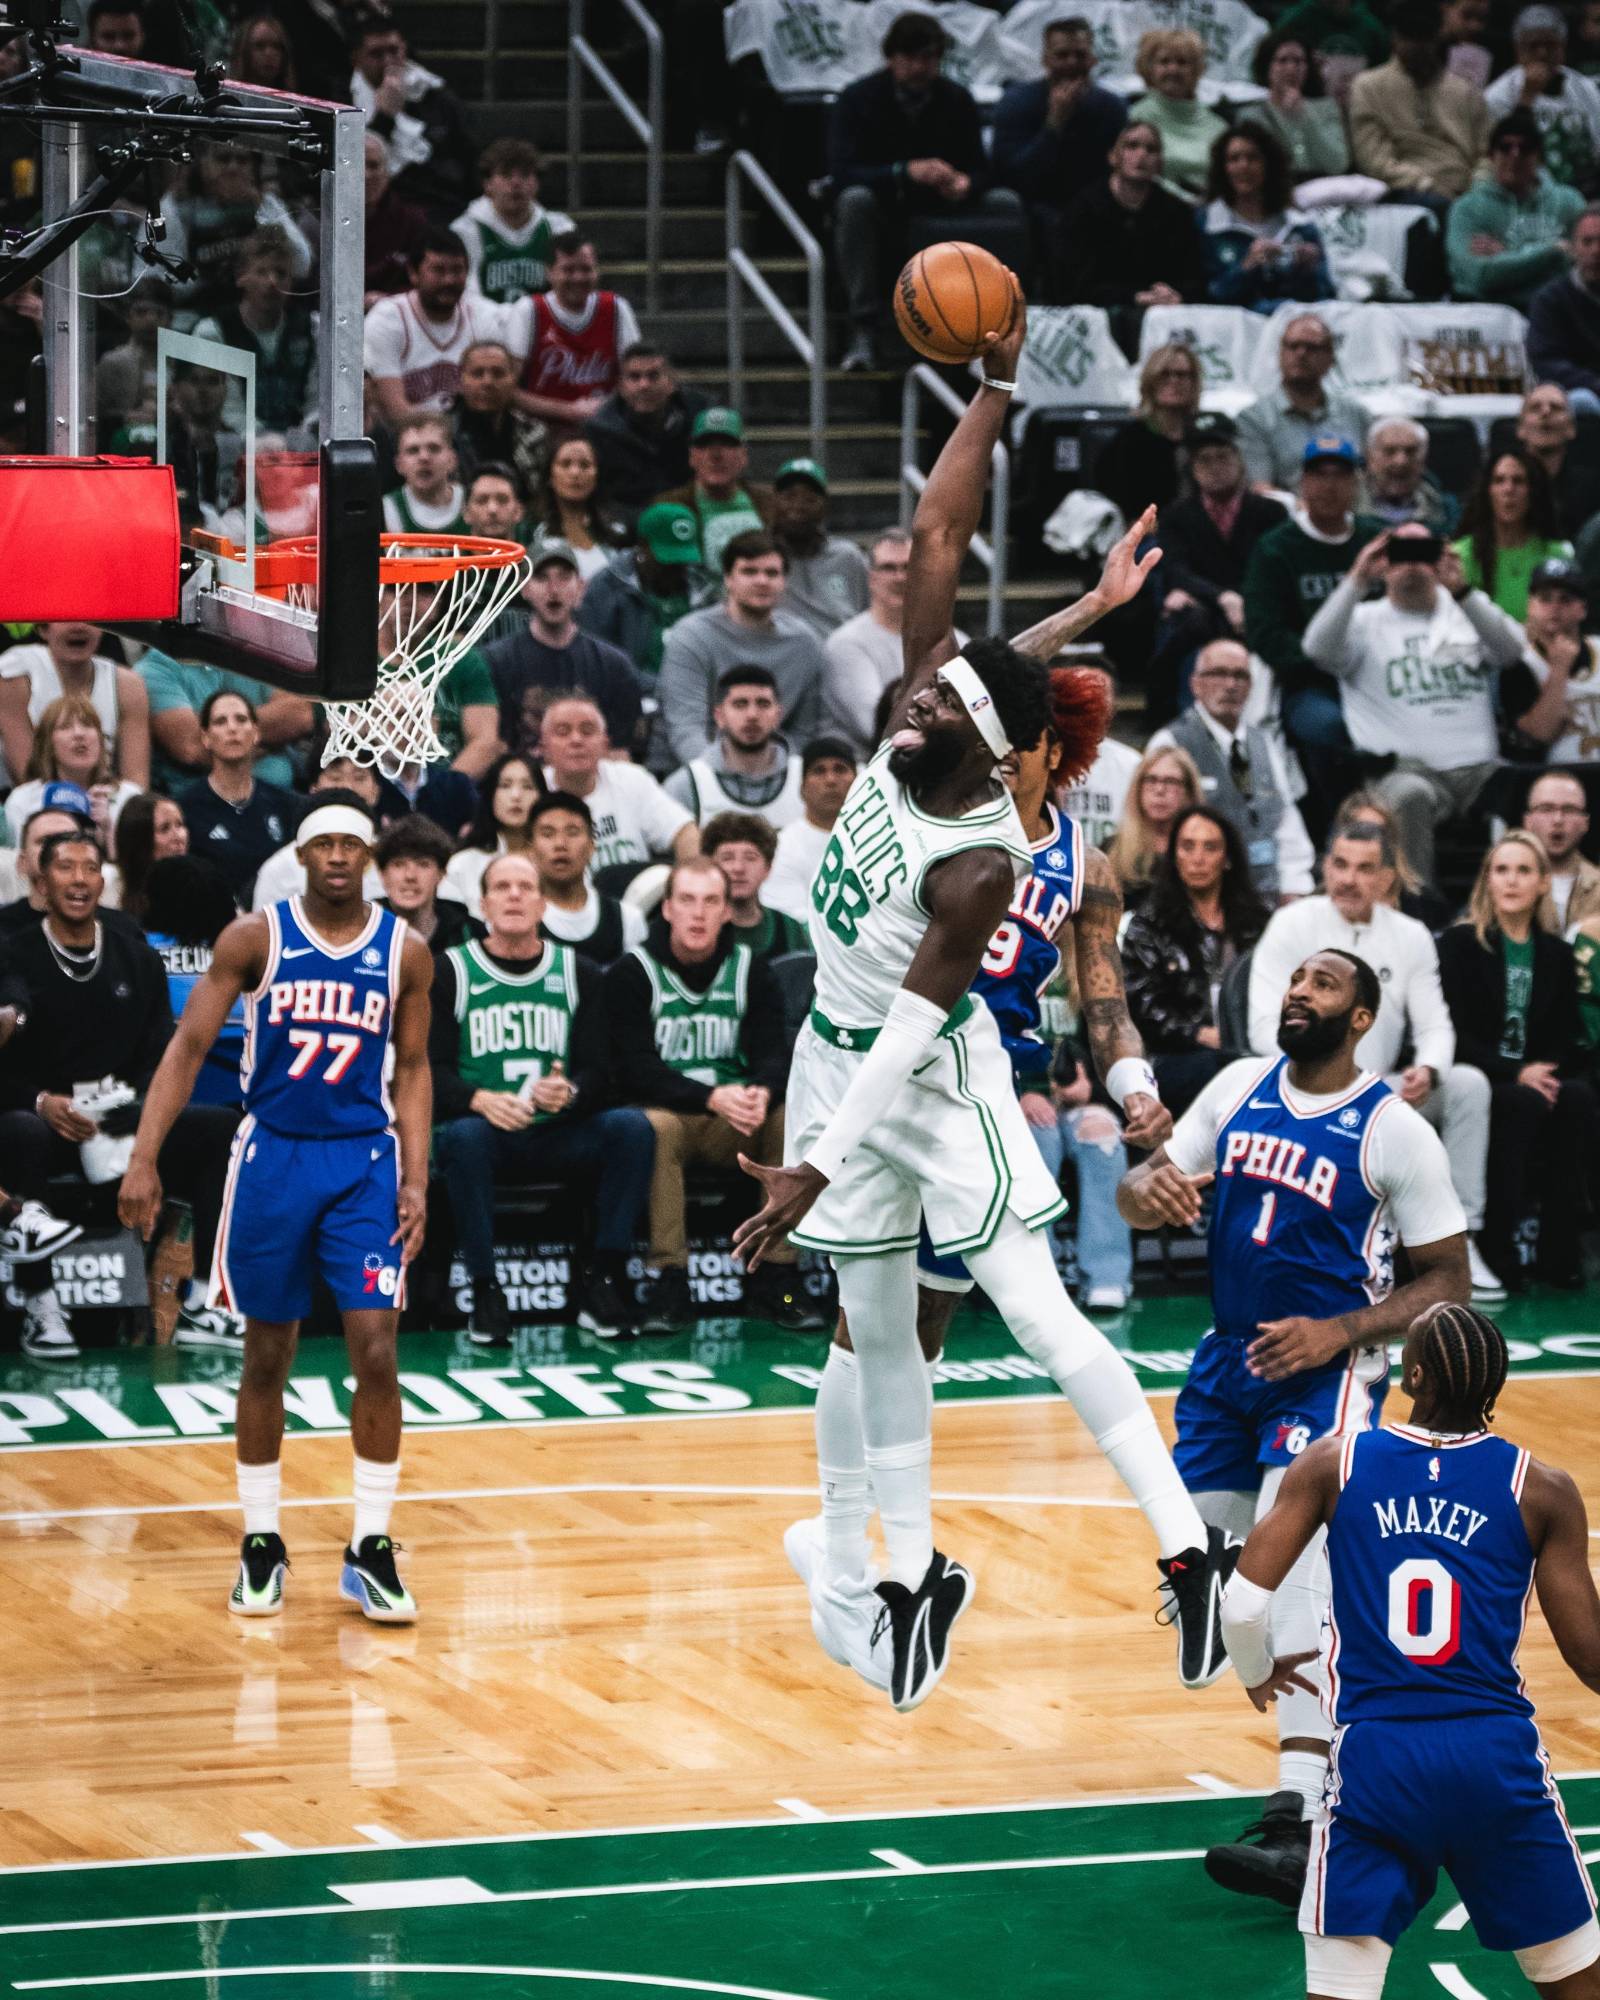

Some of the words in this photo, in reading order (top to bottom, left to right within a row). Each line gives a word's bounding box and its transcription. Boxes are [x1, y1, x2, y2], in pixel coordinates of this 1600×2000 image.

[900, 260, 932, 337] Wilson
[839, 776, 908, 905] CELTICS
[811, 833, 871, 947] 88
[1008, 873, 1071, 942] ILA
[268, 979, 387, 1035] PHILA
[468, 1002, 568, 1058] BOSTON
[288, 1028, 362, 1086] 77
[502, 1059, 543, 1106] 7
[1221, 1131, 1339, 1212] PHILA
[1251, 1191, 1278, 1247] 1
[5, 1280, 122, 1307] CTICS
[363, 1265, 398, 1296] 76
[455, 1285, 567, 1314] CTICS
[1372, 1496, 1489, 1547] MAXEY
[1387, 1558, 1462, 1666] 0
